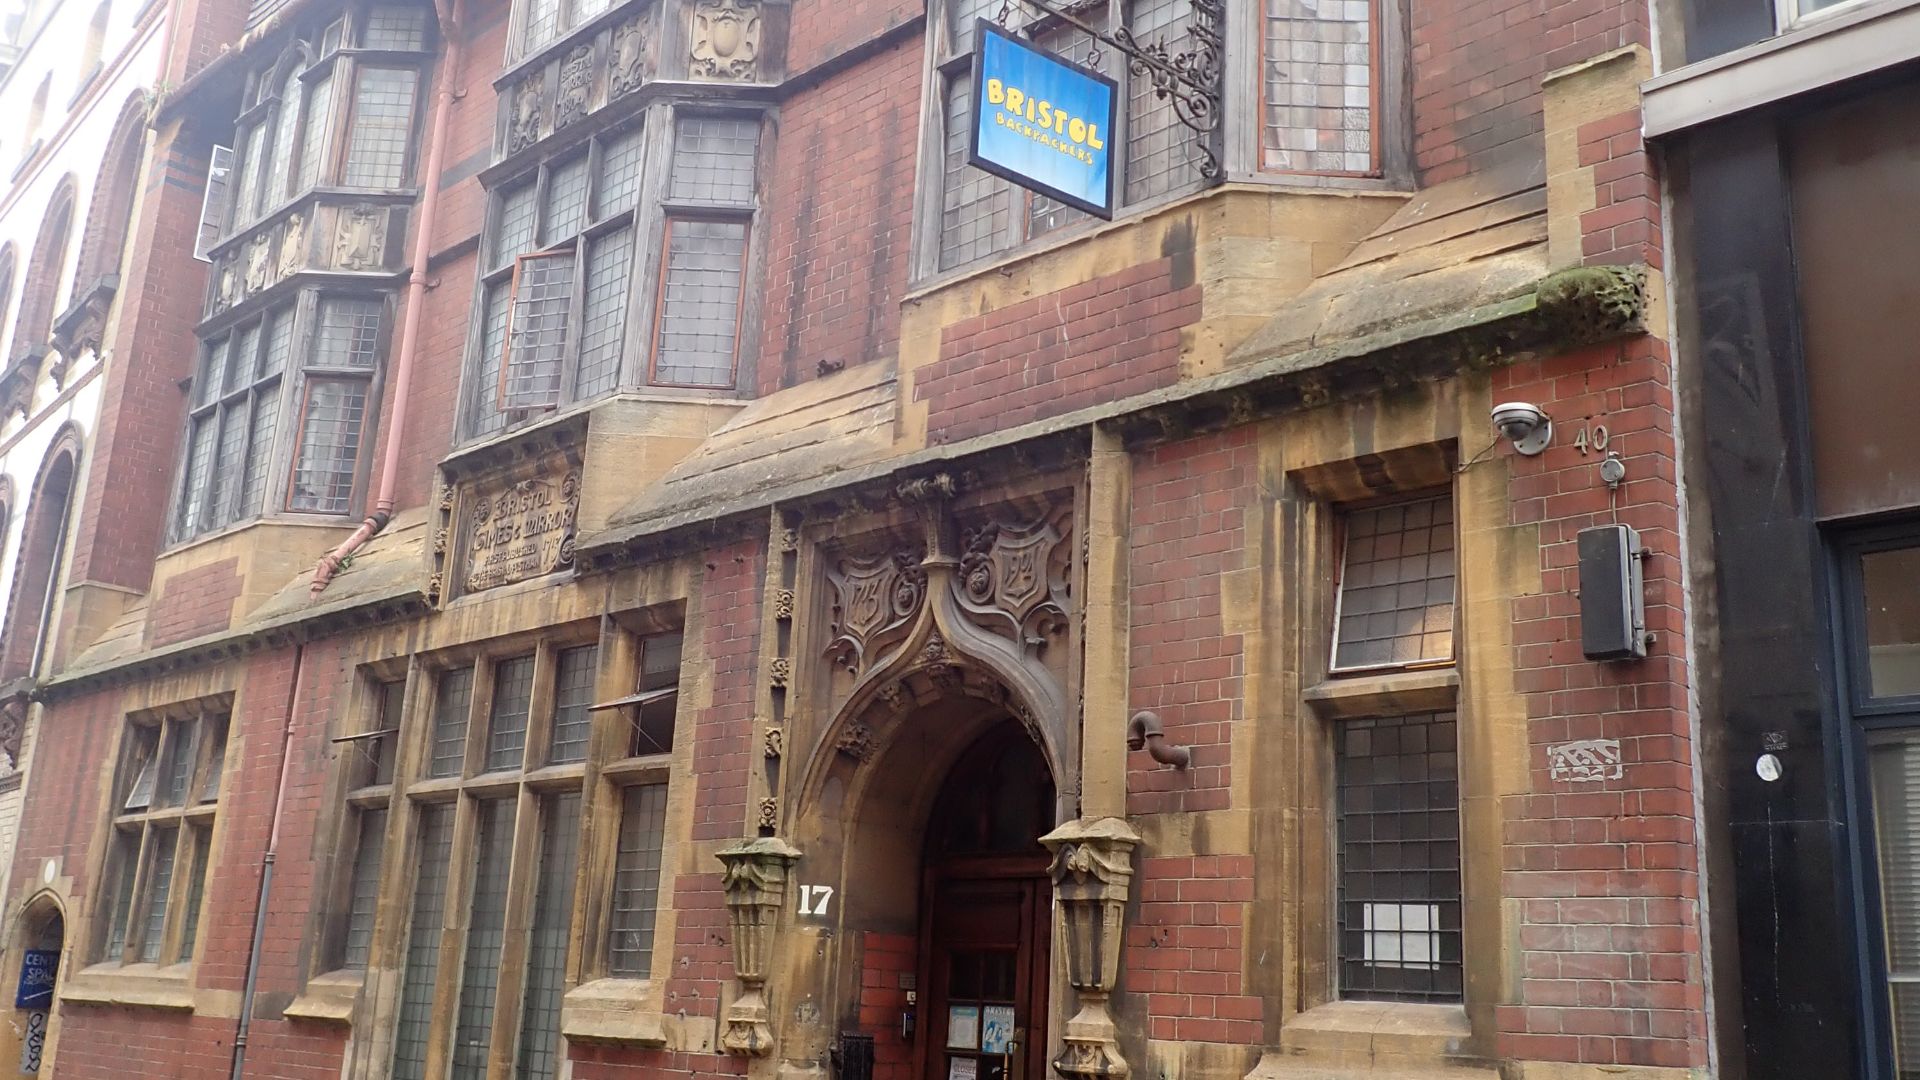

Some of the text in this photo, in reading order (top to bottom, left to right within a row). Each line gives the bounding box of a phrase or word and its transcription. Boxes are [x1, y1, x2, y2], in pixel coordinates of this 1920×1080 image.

[987, 78, 1104, 150] BRISTOL
[996, 112, 1094, 166] BACKPACKERS
[1574, 425, 1608, 455] 40
[492, 487, 552, 521] BRISTOL
[523, 508, 573, 539] MIRROR
[798, 885, 834, 915] 17
